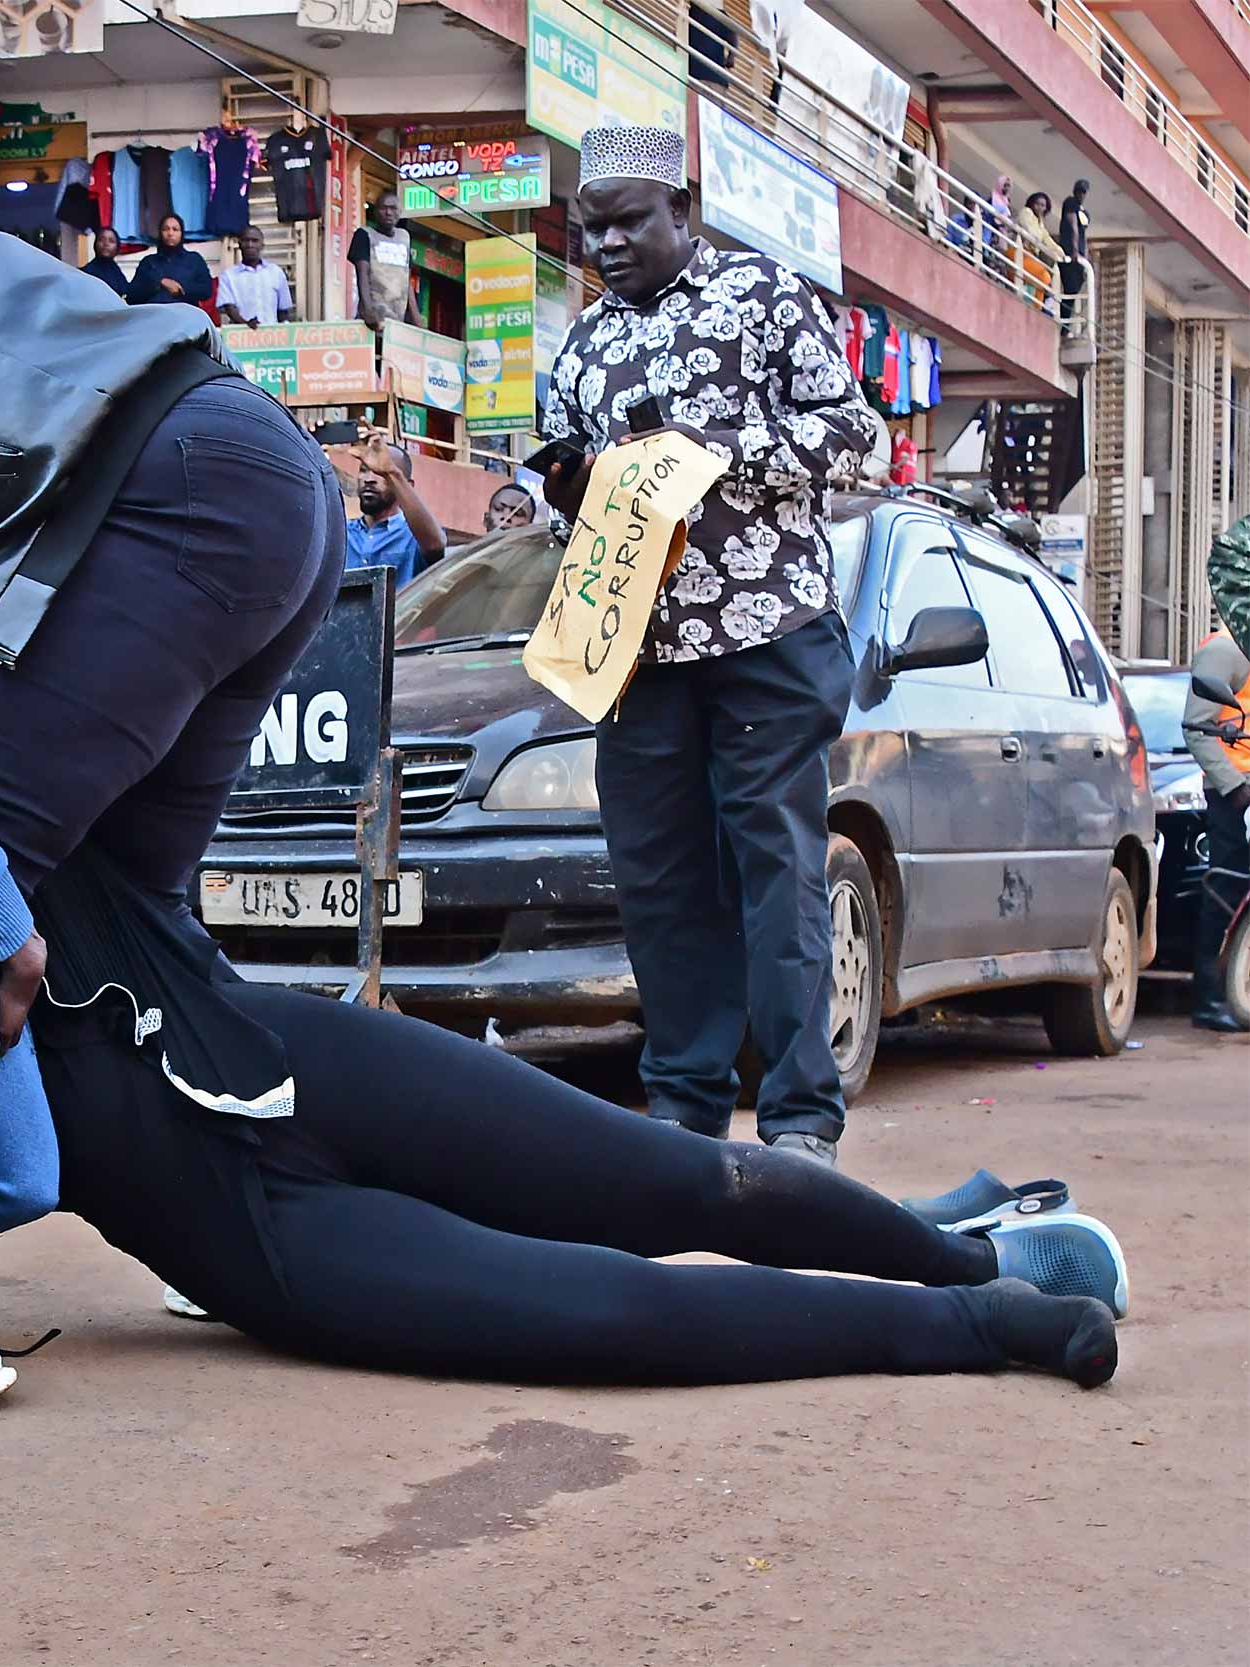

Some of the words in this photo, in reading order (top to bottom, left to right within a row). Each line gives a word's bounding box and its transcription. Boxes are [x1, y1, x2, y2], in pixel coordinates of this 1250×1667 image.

[562, 50, 596, 91] PESA
[400, 147, 457, 164] AIRTEL
[467, 140, 517, 159] VODA
[400, 160, 460, 179] CONGO
[481, 157, 504, 173] TZ
[460, 175, 542, 205] PESA
[497, 310, 532, 327] PESA
[228, 329, 289, 348] SIMON
[295, 327, 367, 345] AGENCY
[256, 366, 296, 383] PESA
[302, 370, 368, 381] vodacom
[578, 535, 607, 608] NO
[605, 462, 640, 517] TO
[584, 454, 681, 676] CORRUPTION
[547, 516, 598, 638] SAY
[321, 879, 400, 918] 48D
